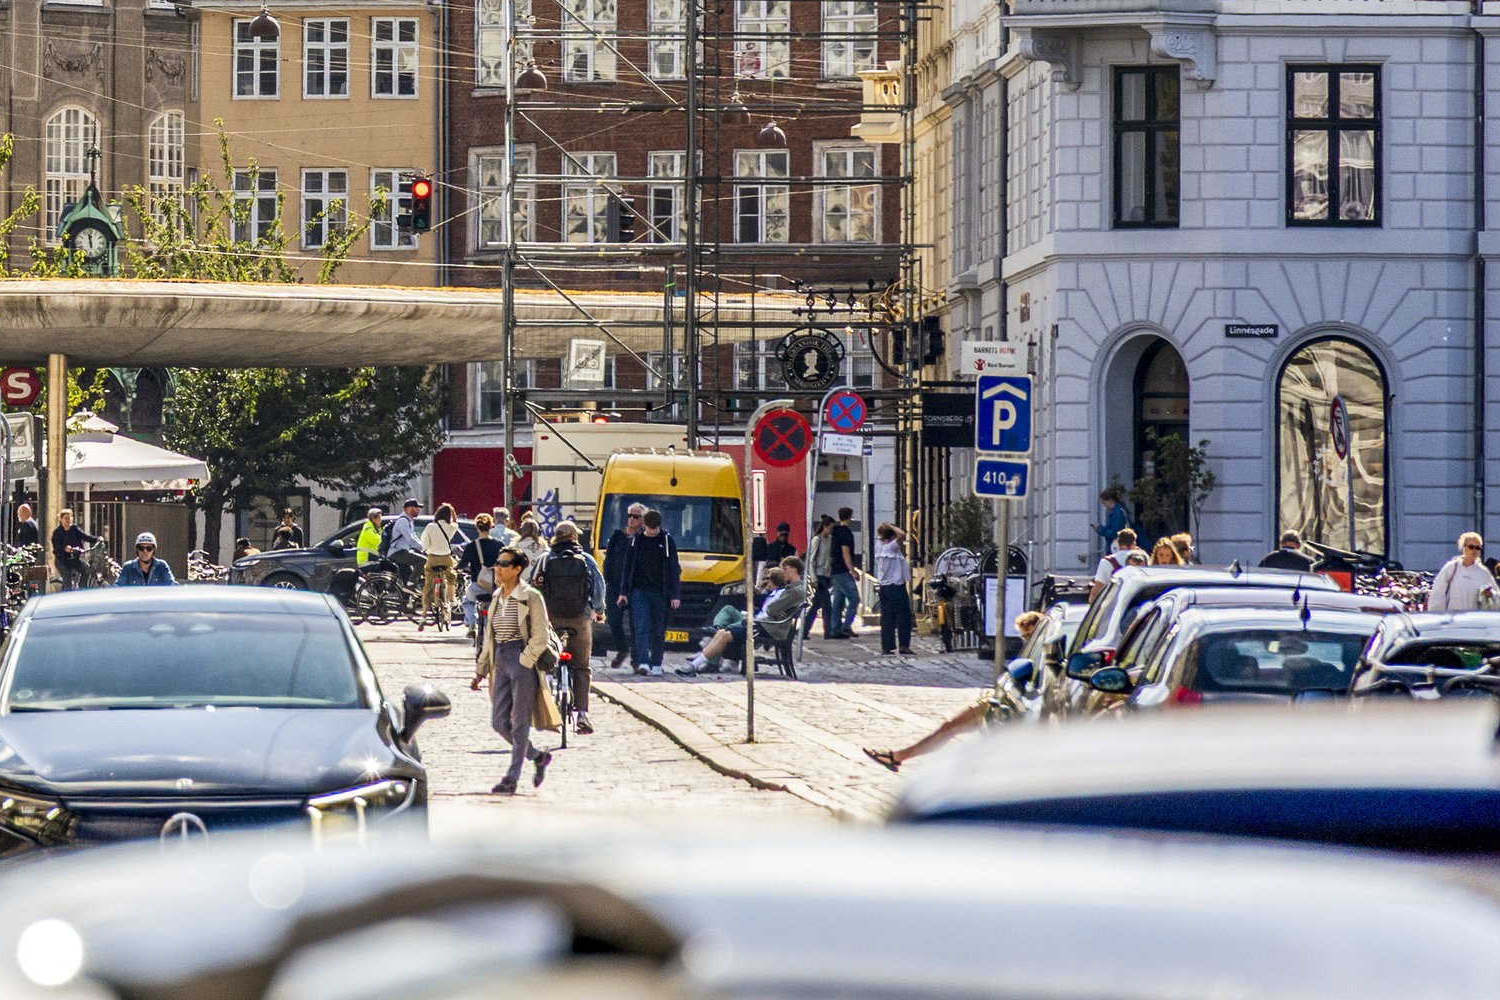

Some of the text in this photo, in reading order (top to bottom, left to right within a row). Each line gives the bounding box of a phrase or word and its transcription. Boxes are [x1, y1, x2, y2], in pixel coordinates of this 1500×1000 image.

[7, 372, 32, 399] S
[992, 400, 1016, 445] P
[983, 471, 1006, 485] 410
